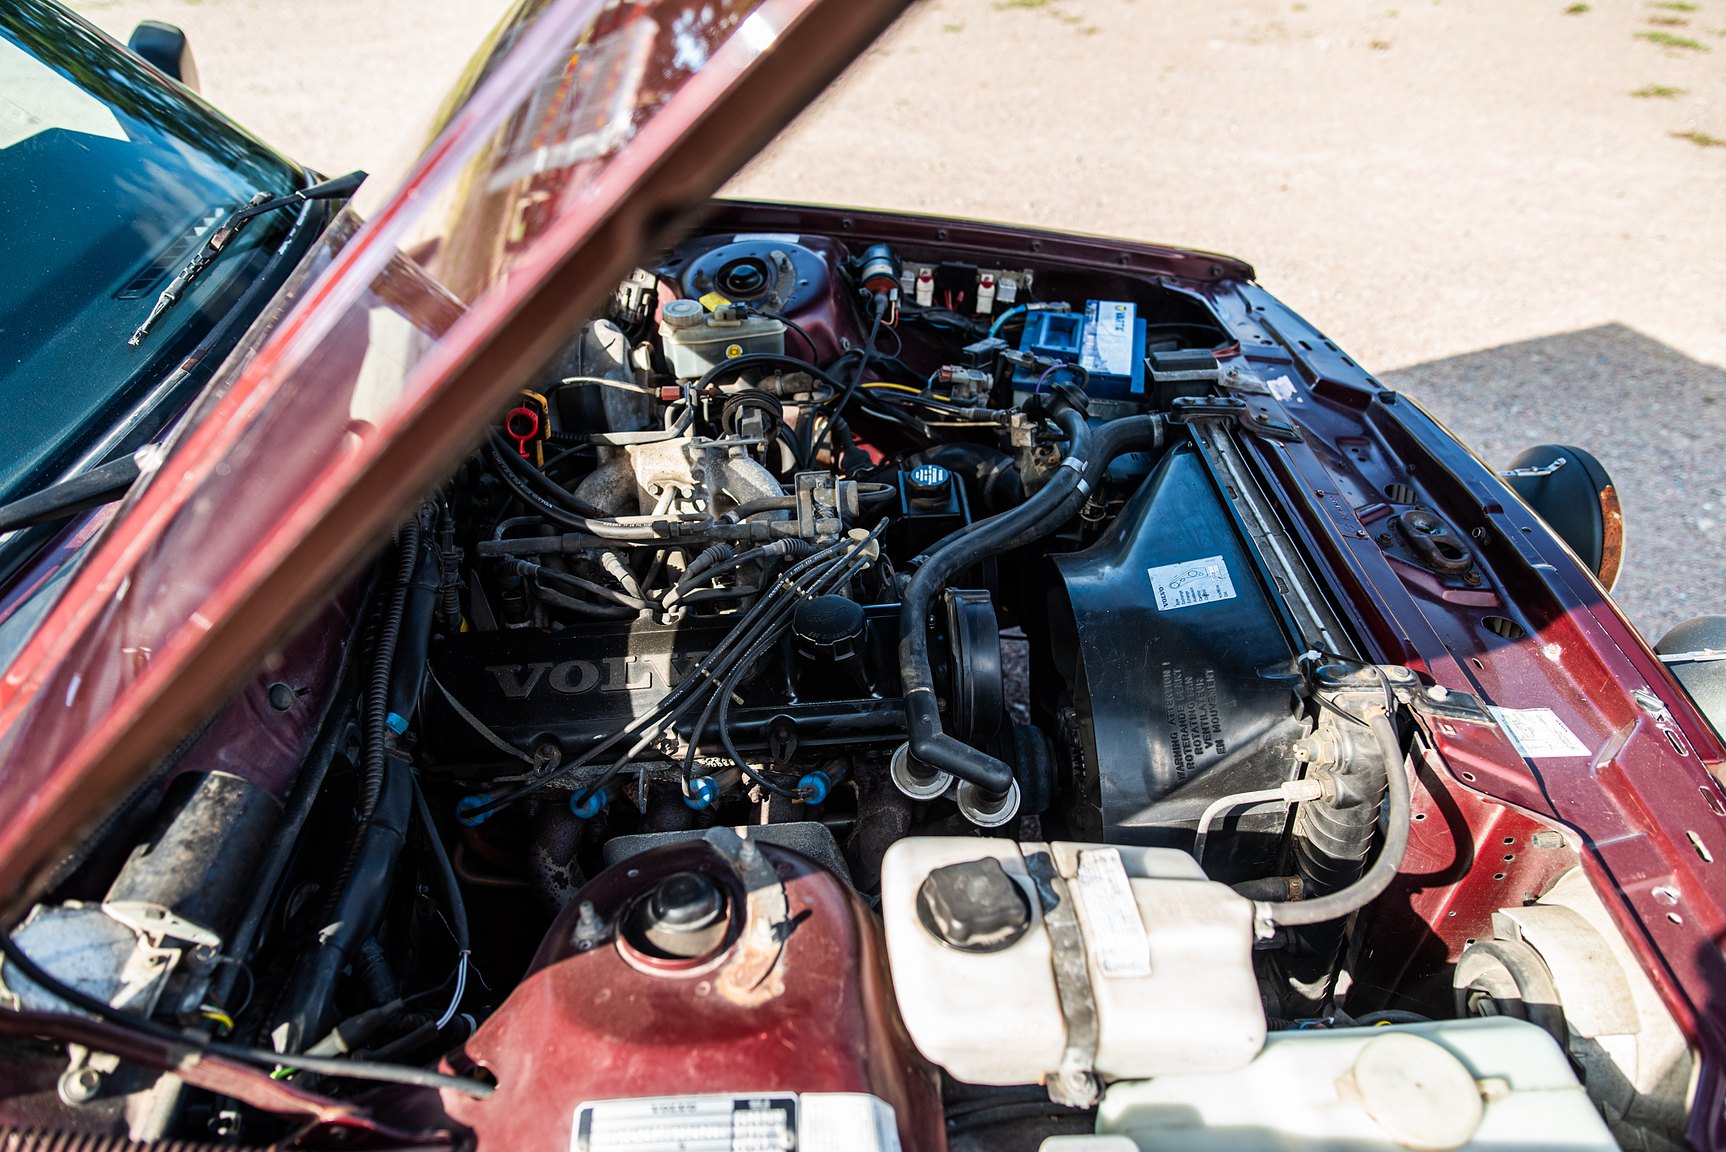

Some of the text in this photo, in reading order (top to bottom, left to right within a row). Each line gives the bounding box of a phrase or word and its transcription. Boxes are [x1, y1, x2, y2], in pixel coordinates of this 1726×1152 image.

[1159, 587, 1168, 607] VOLVO
[484, 651, 712, 698] VOLV
[1163, 670, 1176, 724] ATTENTION
[1179, 706, 1194, 770] ROTERANDE
[1185, 677, 1203, 755] ROTATING FAN
[1196, 679, 1213, 749] VENTILATEUR
[1206, 670, 1226, 754] EN MOUVEMENT
[1170, 732, 1185, 780] WARNING
